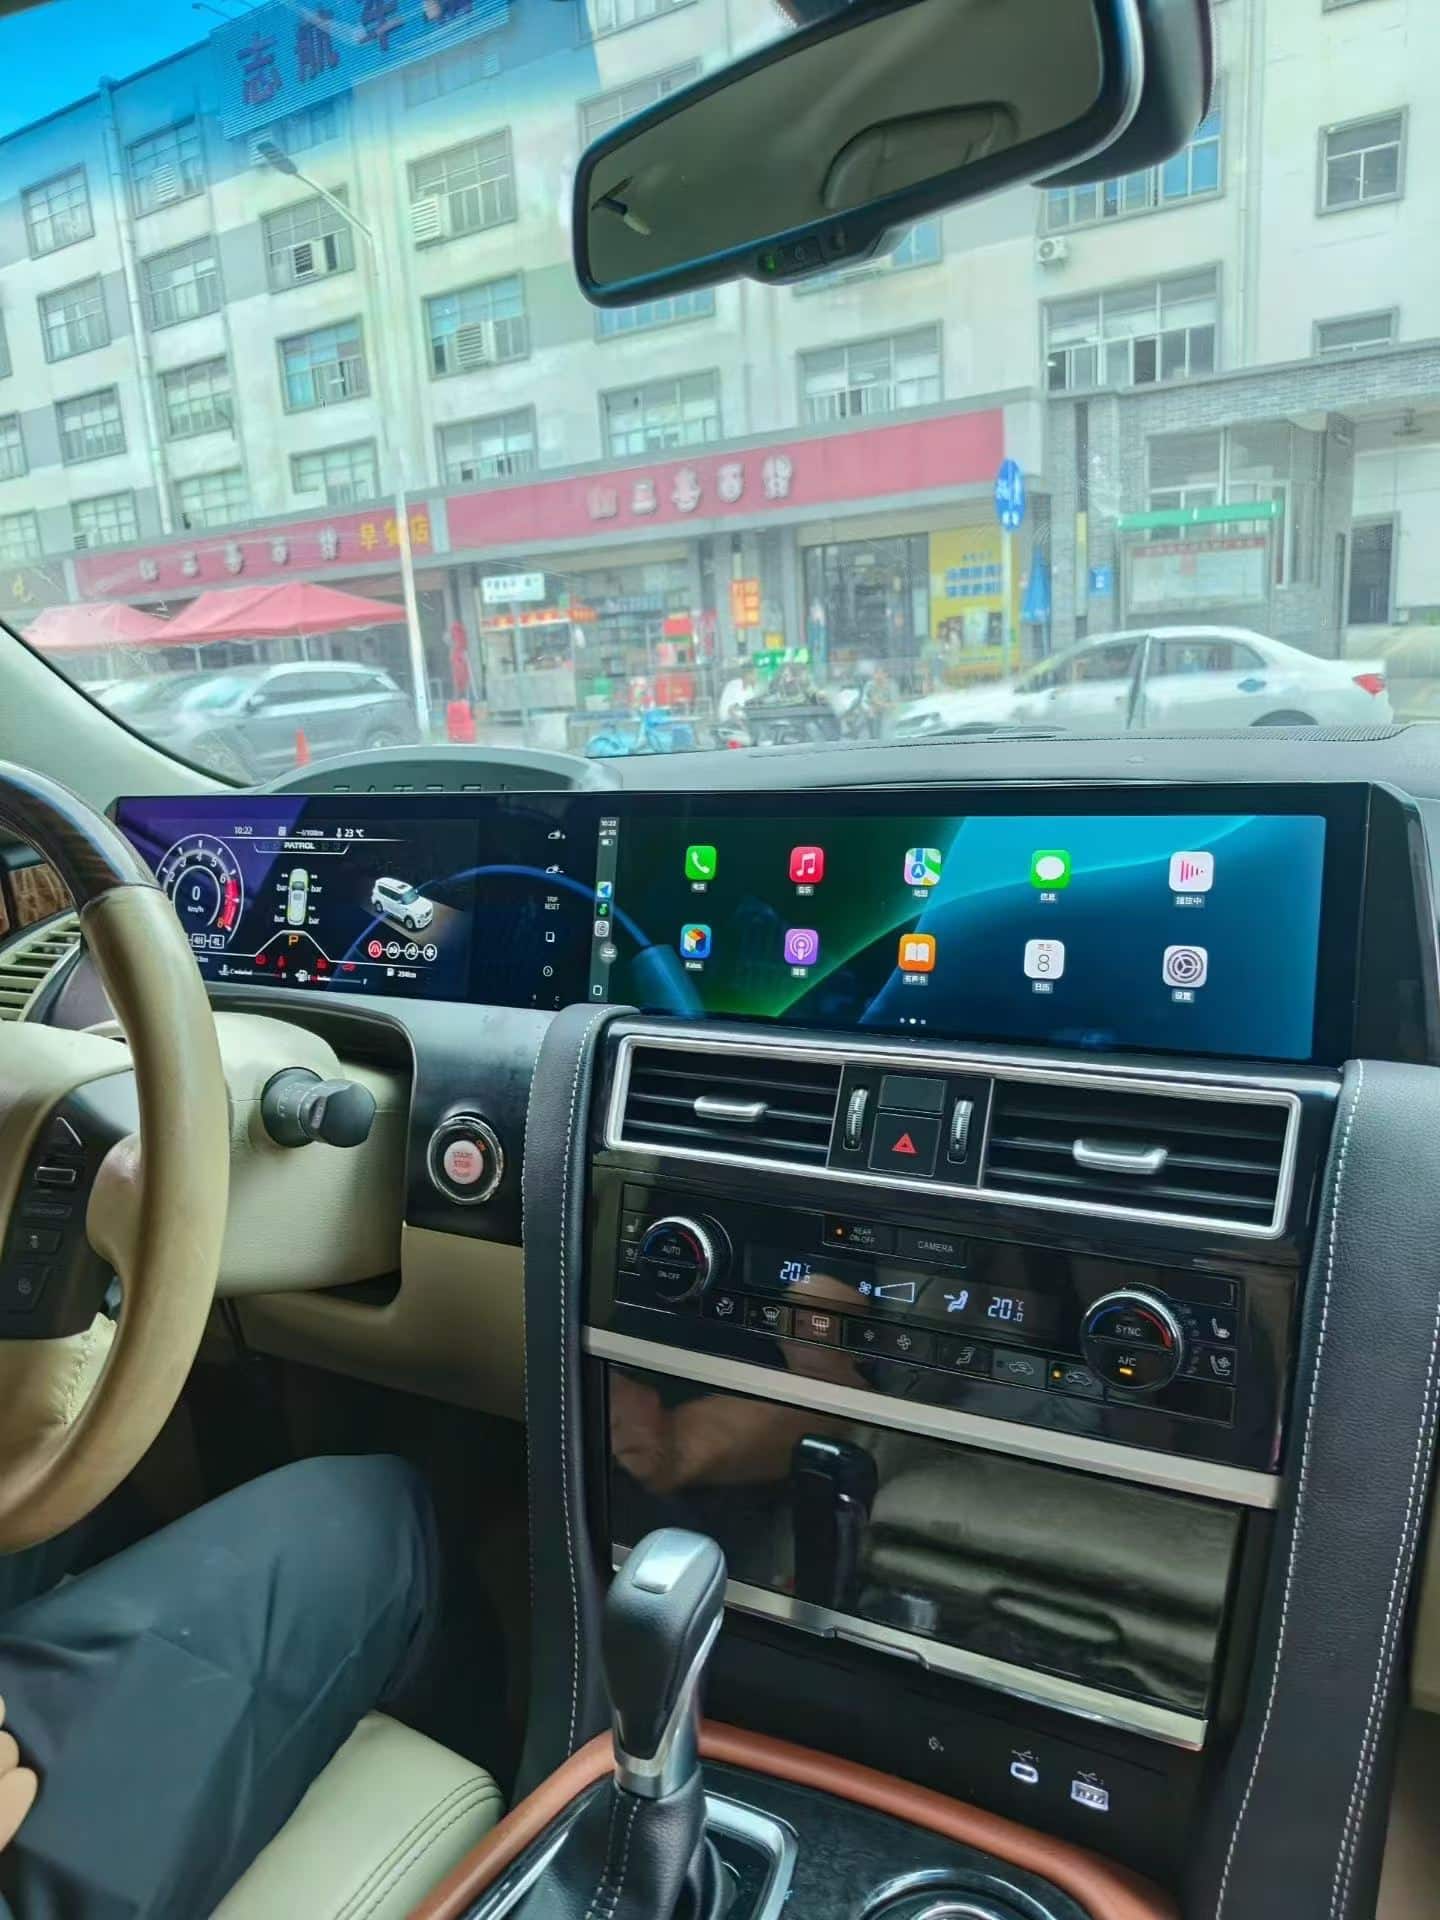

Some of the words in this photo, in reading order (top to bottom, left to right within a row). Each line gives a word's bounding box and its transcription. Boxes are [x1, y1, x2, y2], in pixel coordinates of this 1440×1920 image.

[345, 829, 353, 837] 23
[284, 842, 315, 850] PATROL
[192, 886, 201, 901] 0
[308, 915, 320, 925] bar
[288, 935, 299, 946] P
[1038, 954, 1050, 972] 8
[661, 1245, 681, 1256] AUTO
[917, 1240, 954, 1253] CAMERA
[1115, 1324, 1142, 1337] SYNC
[1118, 1356, 1137, 1367] A/C
